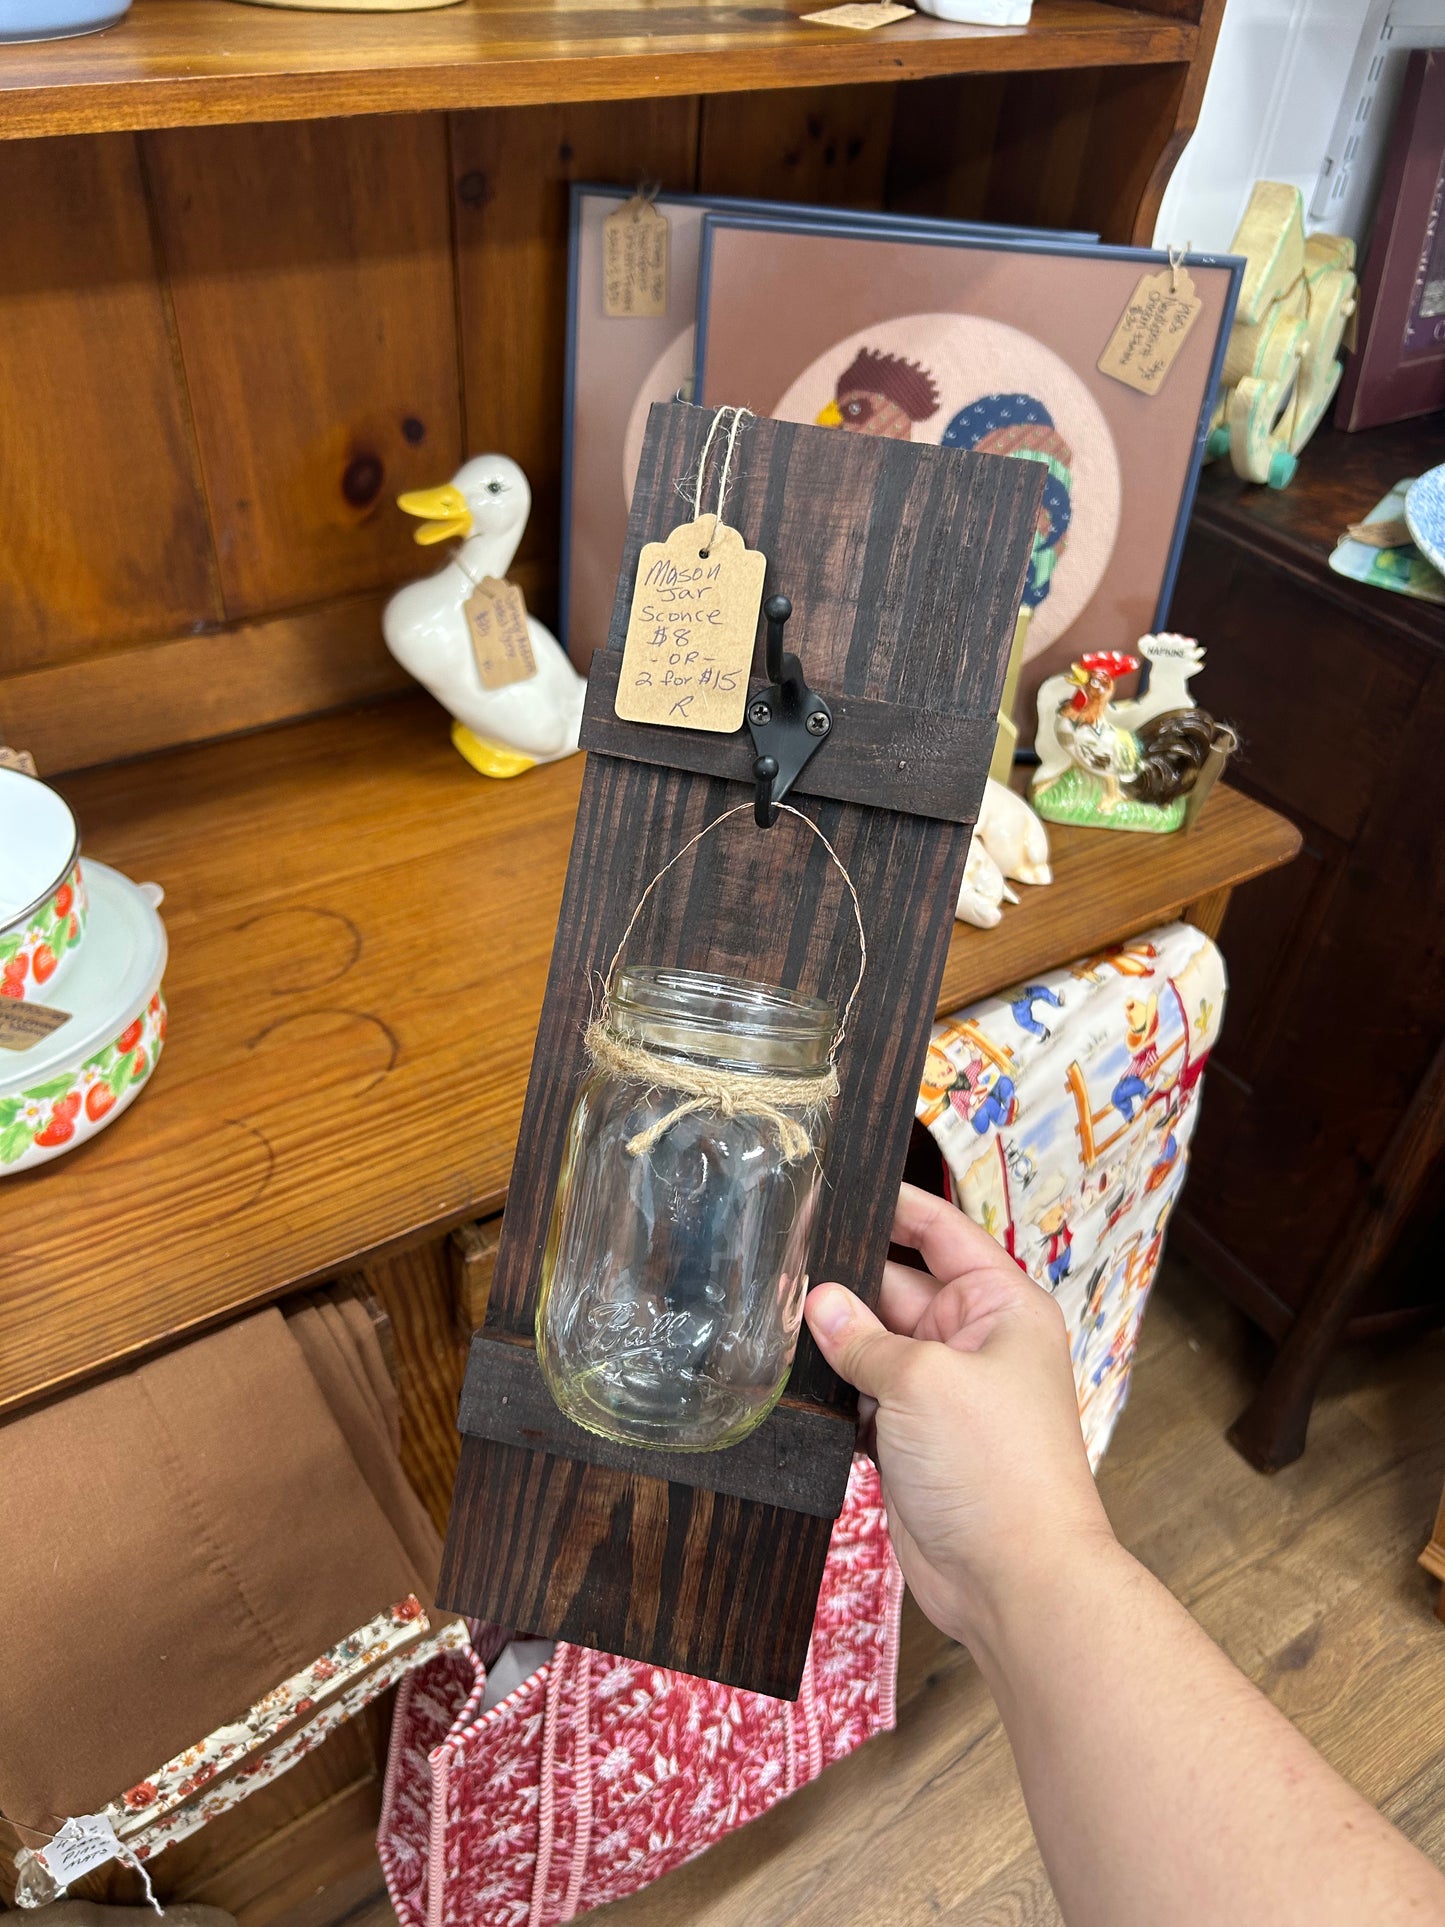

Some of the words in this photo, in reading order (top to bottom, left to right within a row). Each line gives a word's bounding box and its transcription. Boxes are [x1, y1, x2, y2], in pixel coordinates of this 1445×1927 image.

[644, 559, 722, 587] Mason
[656, 586, 713, 602] Jar
[638, 605, 724, 625] Sconce
[646, 625, 692, 647] $8
[635, 671, 653, 687] 2
[660, 669, 693, 687] for
[698, 667, 743, 692] $15
[584, 1301, 691, 1351] Ball
